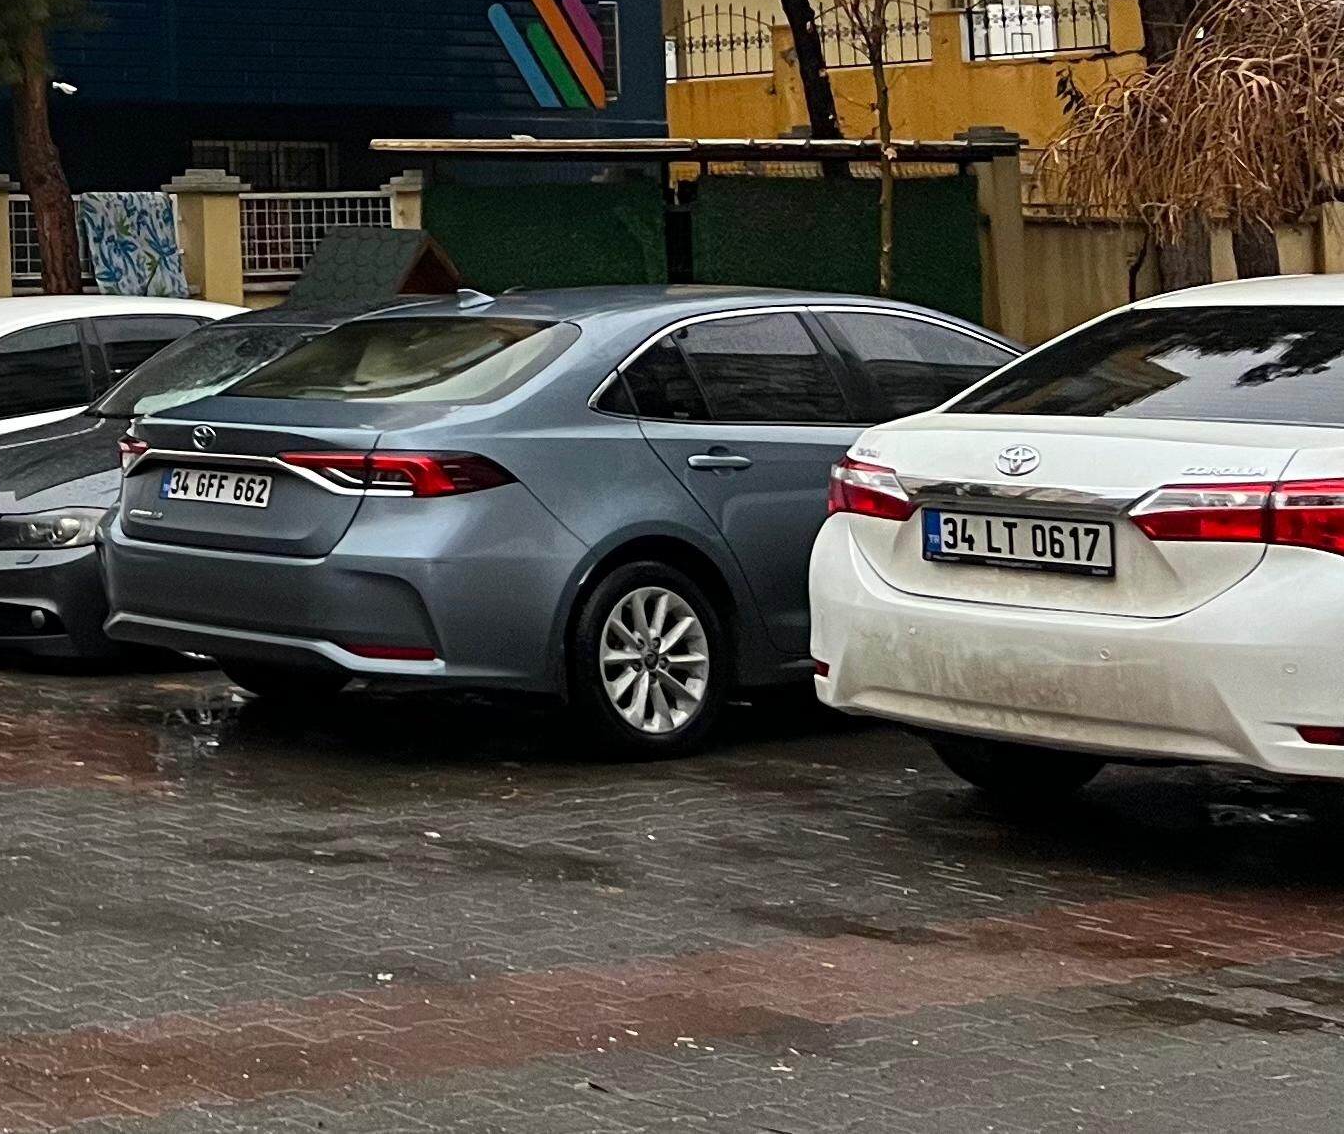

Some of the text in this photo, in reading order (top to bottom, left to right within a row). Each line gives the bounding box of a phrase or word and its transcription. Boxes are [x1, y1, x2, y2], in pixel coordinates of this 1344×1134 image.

[170, 470, 268, 504] 34 GFF 662
[943, 517, 1100, 562] 34 LT 0617
